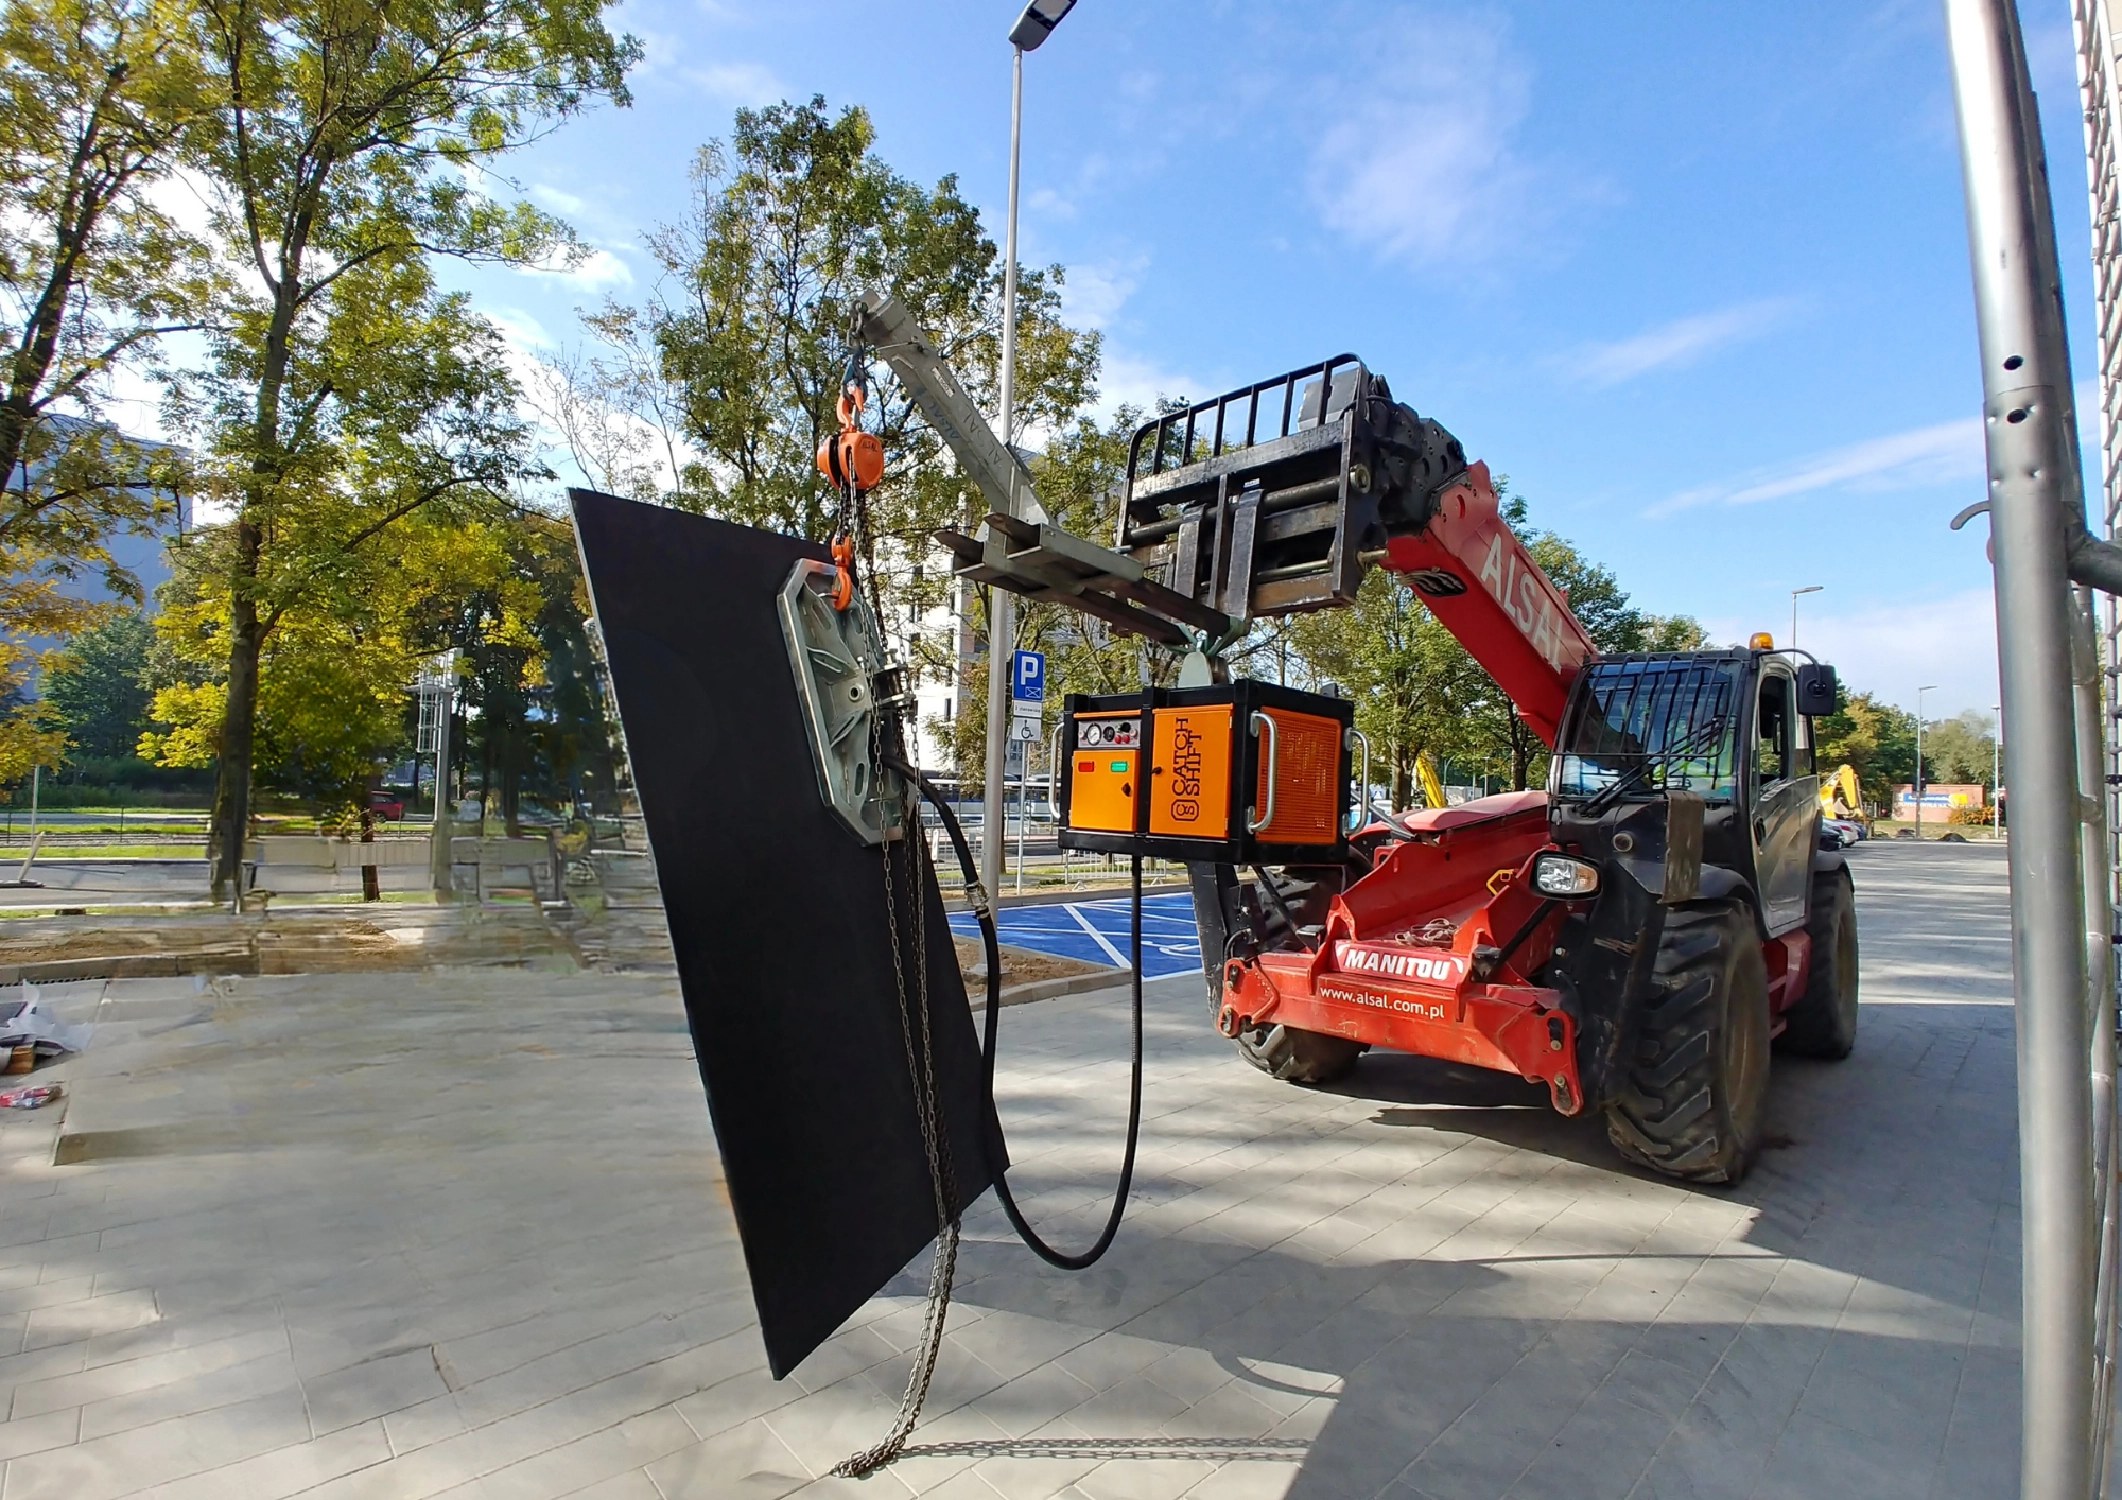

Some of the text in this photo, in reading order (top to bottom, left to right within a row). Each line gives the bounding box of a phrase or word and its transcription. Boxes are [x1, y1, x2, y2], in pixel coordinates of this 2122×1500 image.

[928, 402, 959, 439] ALSAL
[1020, 655, 1039, 686] P
[1172, 716, 1189, 797] CATCH
[1185, 729, 1202, 797] SHIFT
[1344, 948, 1450, 981] MANITOU
[1320, 986, 1445, 1019] www.alsal.com.pl
